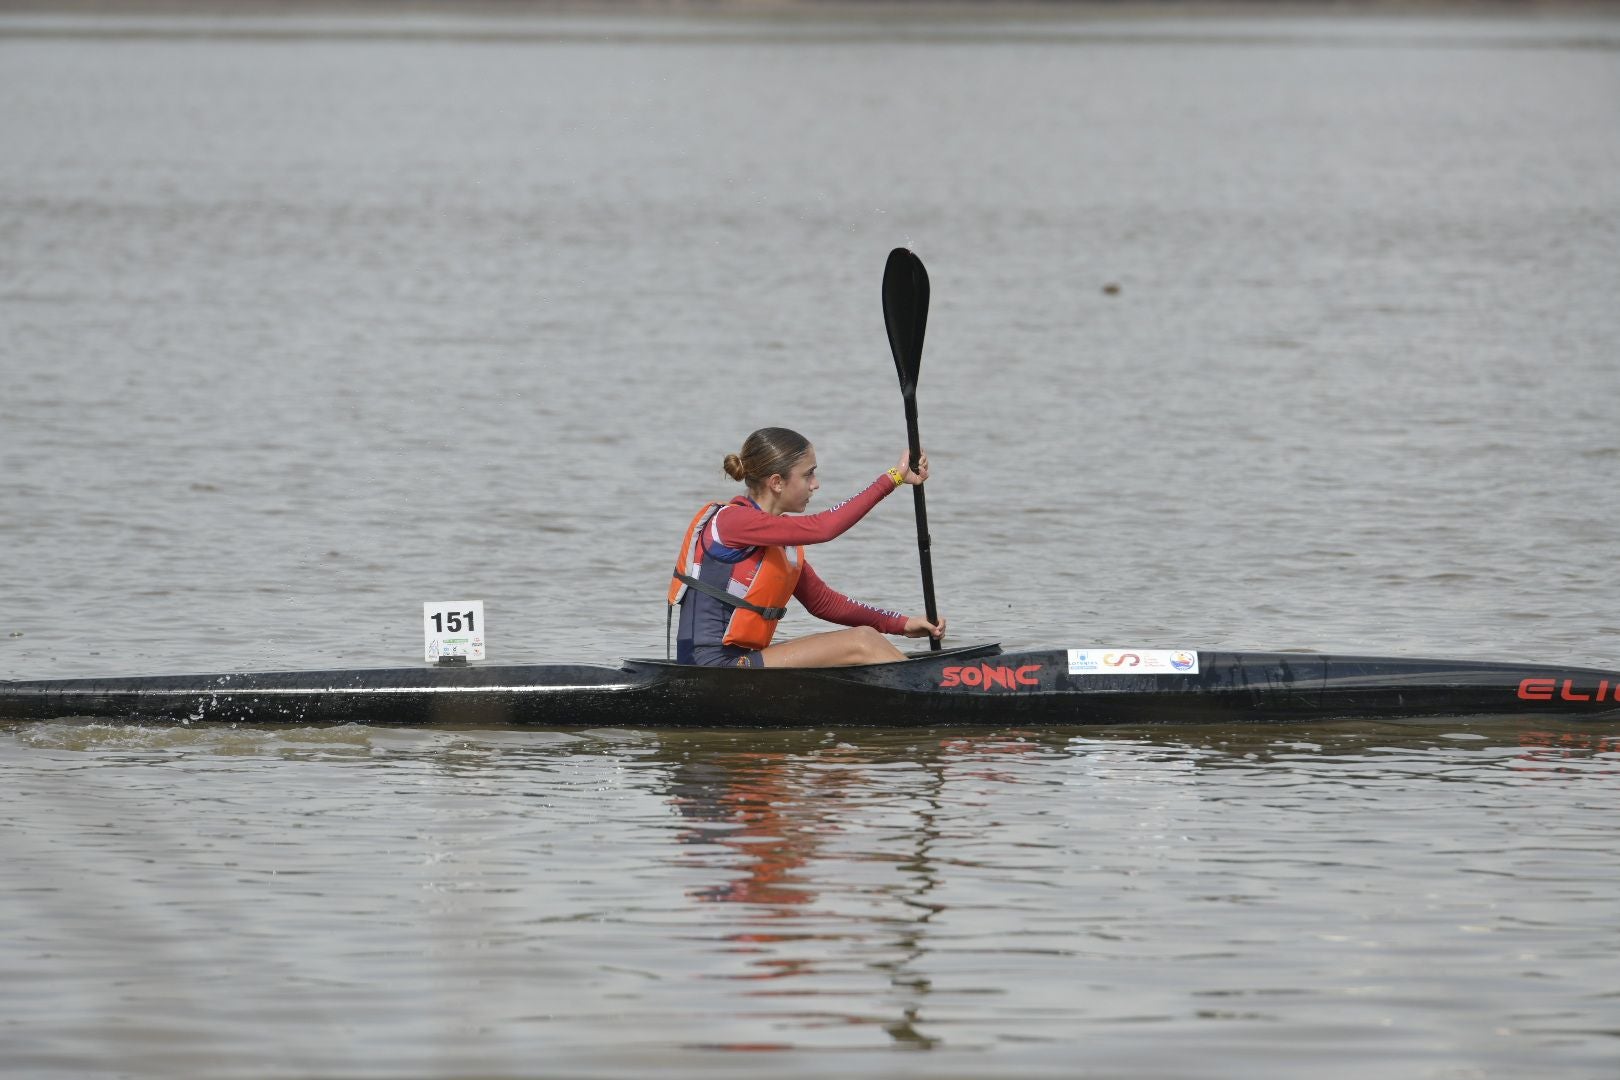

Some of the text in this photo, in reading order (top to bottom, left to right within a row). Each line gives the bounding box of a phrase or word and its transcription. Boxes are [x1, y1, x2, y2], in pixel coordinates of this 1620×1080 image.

[431, 610, 475, 633] 151
[939, 663, 1043, 692] SONIC
[1517, 678, 1620, 702] ELI
